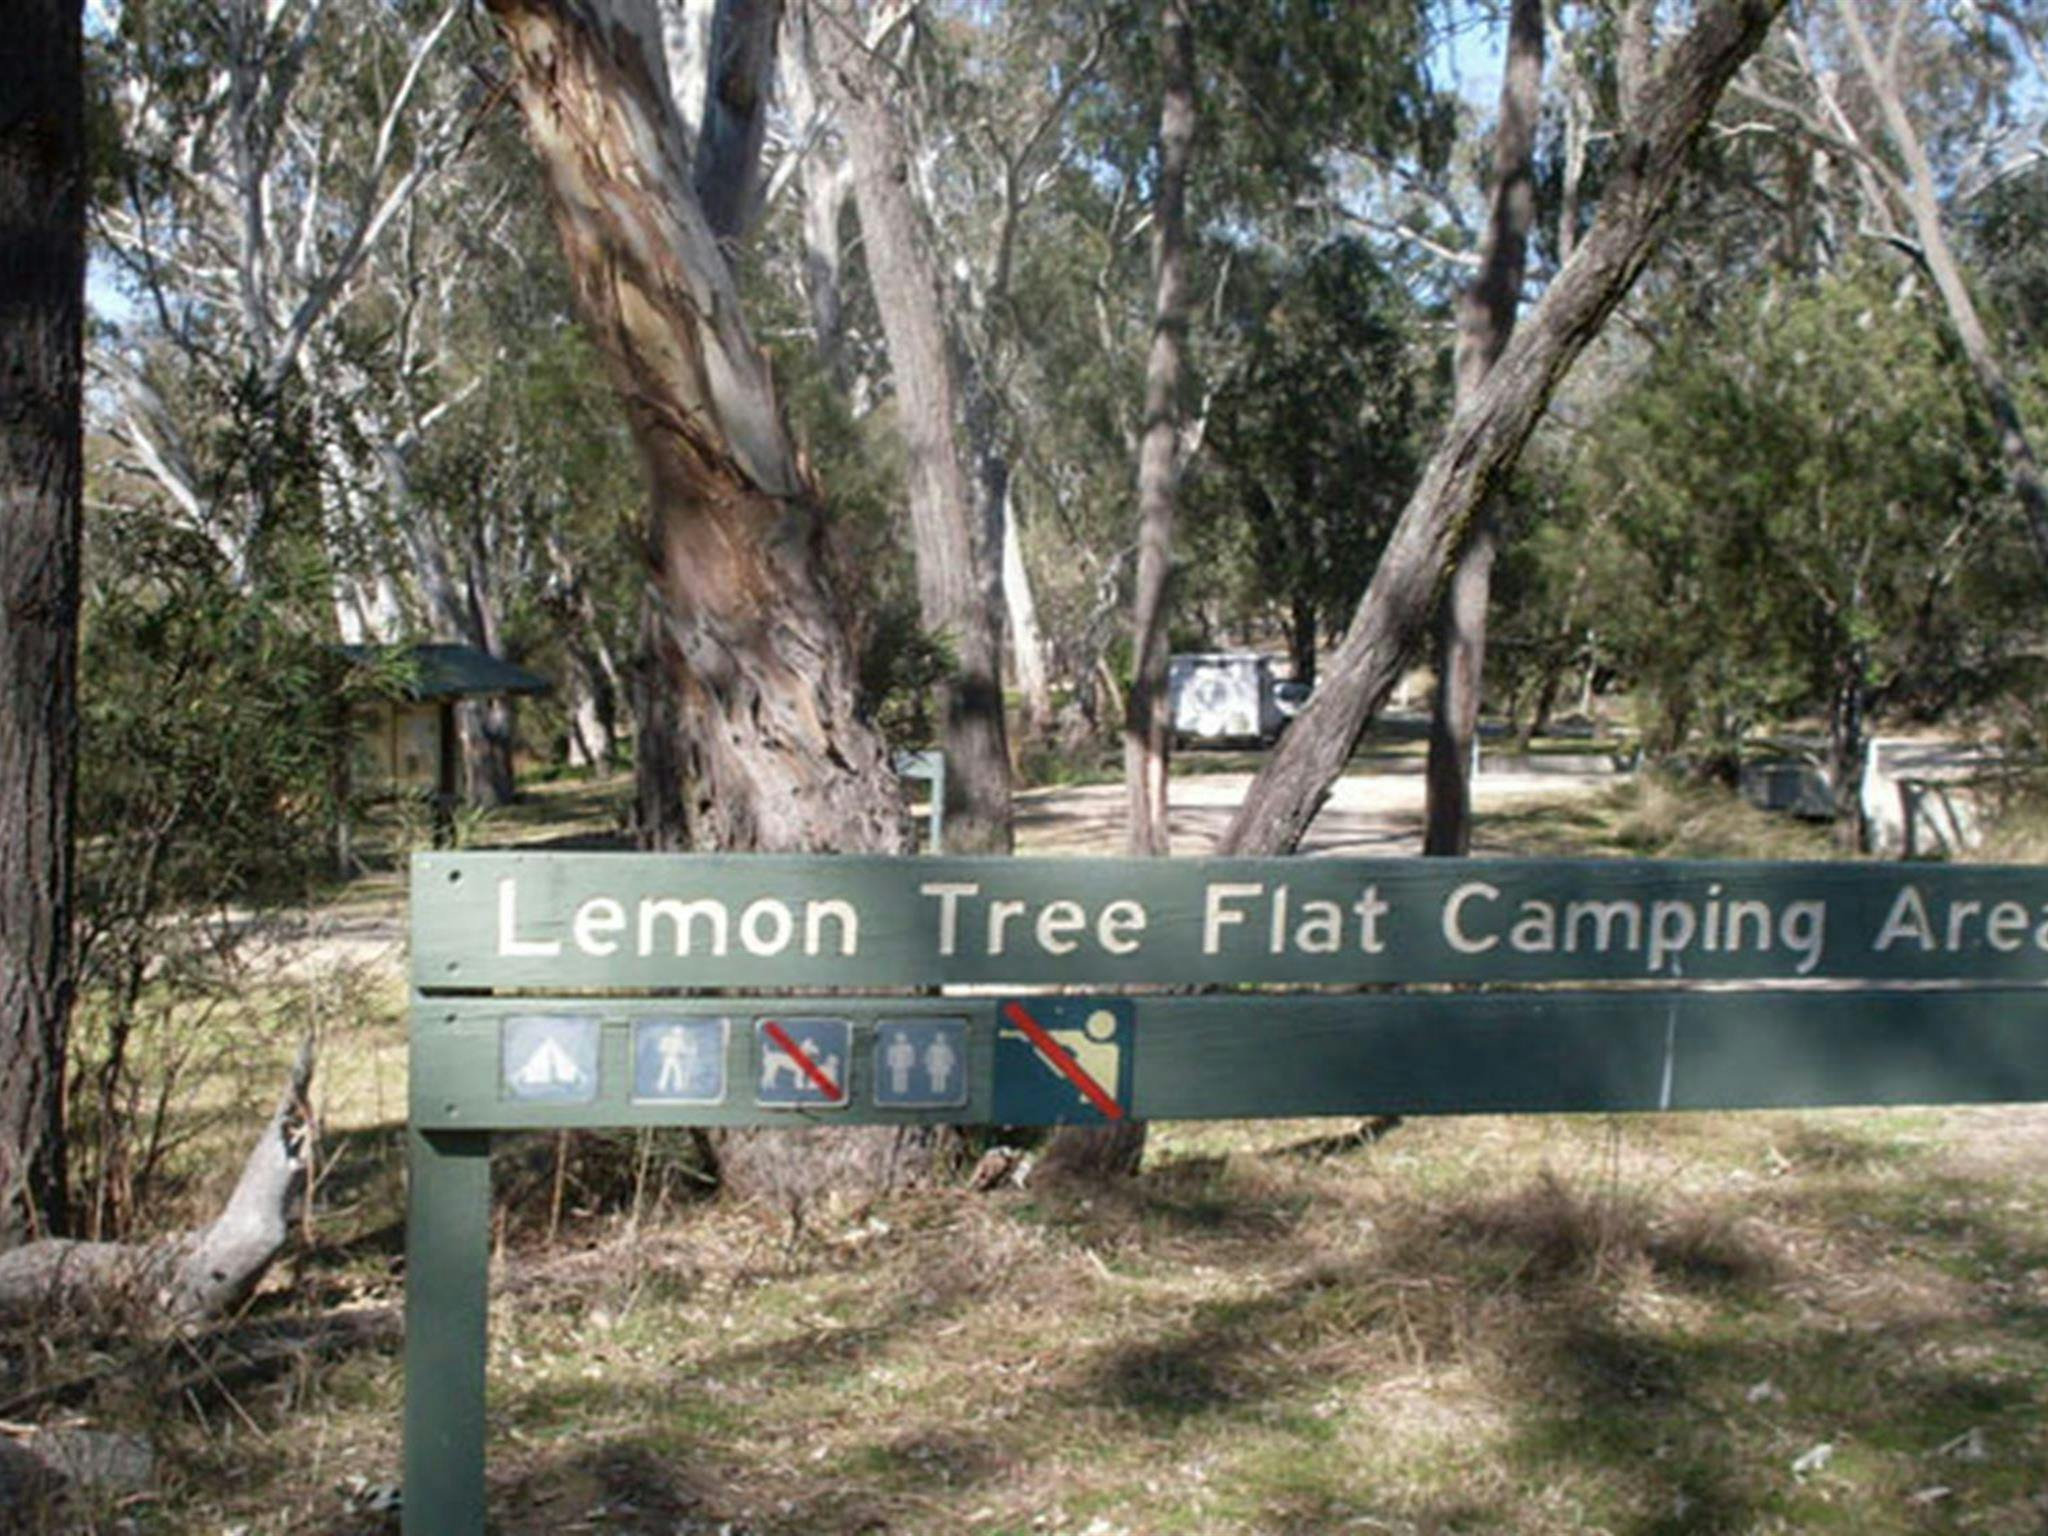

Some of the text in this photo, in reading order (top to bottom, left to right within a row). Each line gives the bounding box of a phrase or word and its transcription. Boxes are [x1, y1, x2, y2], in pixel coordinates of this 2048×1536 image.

[498, 878, 860, 957] Lemon
[921, 882, 1147, 956] Tree
[1203, 882, 1390, 955] Flat
[1442, 881, 1826, 974] Camping
